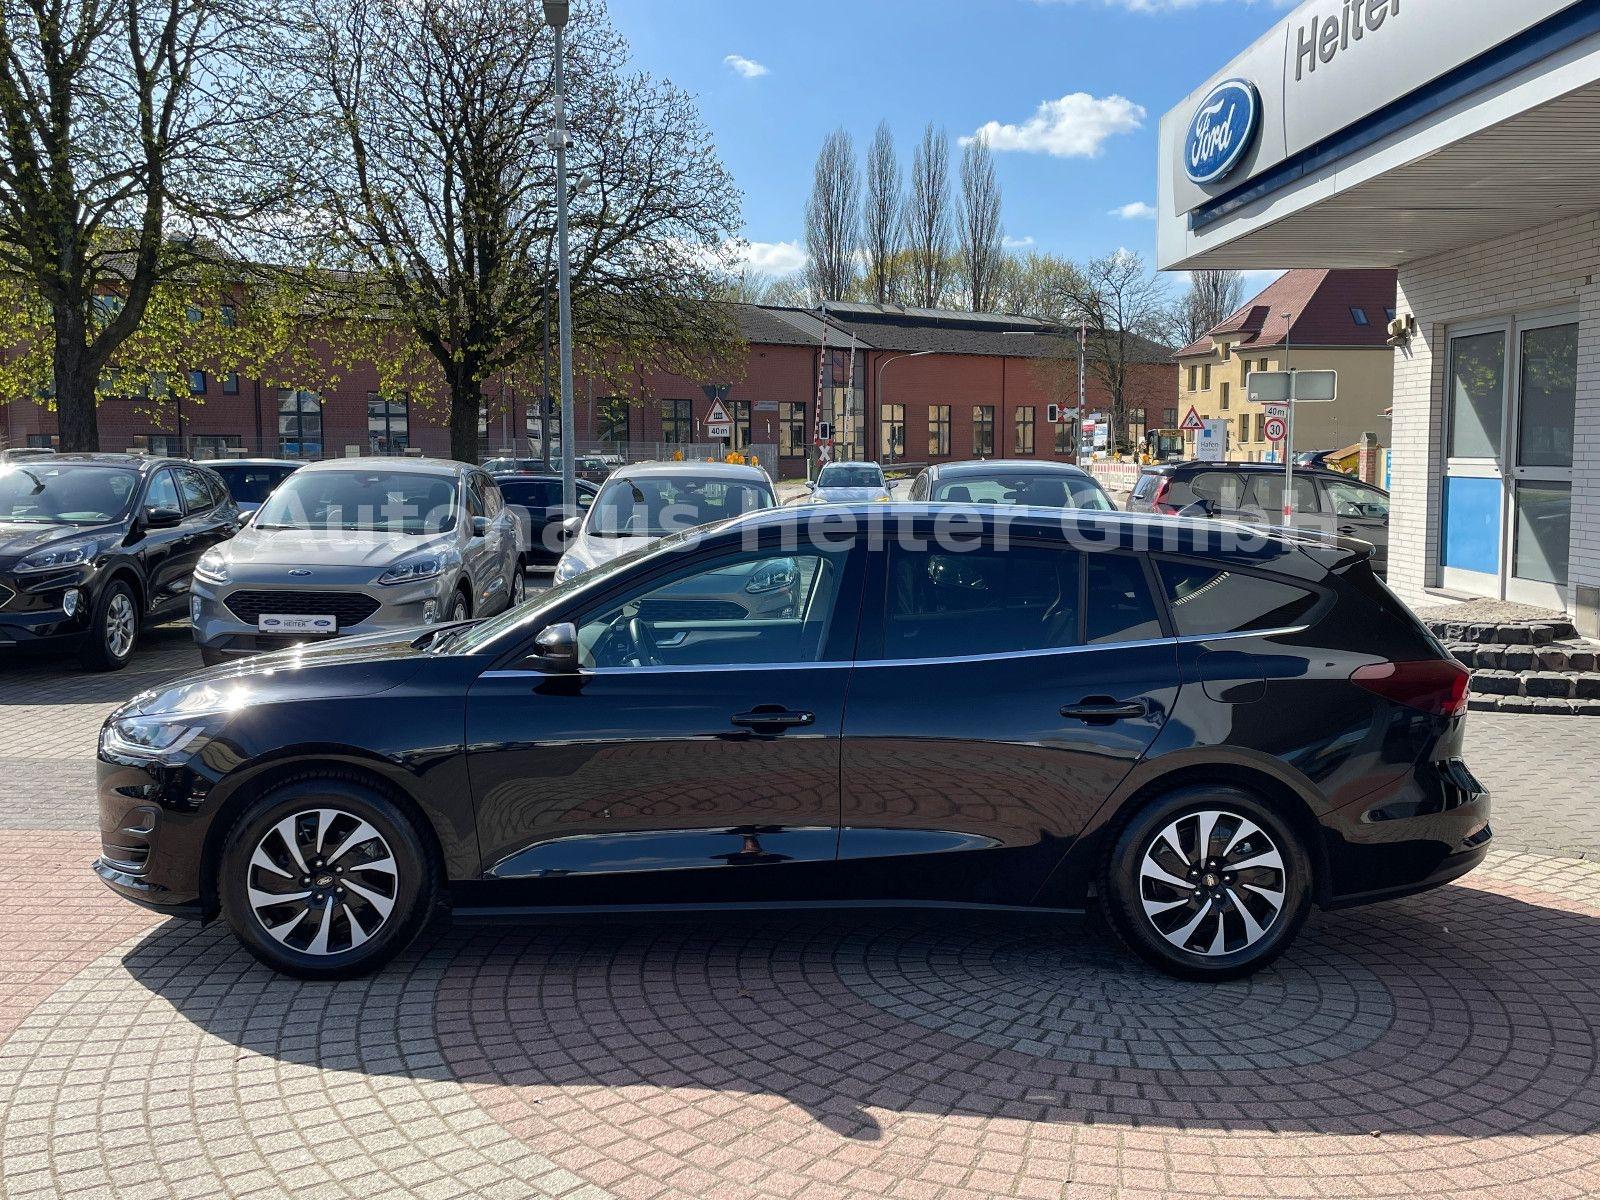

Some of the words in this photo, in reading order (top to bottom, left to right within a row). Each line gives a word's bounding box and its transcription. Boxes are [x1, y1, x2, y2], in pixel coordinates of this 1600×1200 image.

[1191, 98, 1236, 168] Ford
[1269, 424, 1281, 436] 30
[1200, 440, 1219, 448] Hafen
